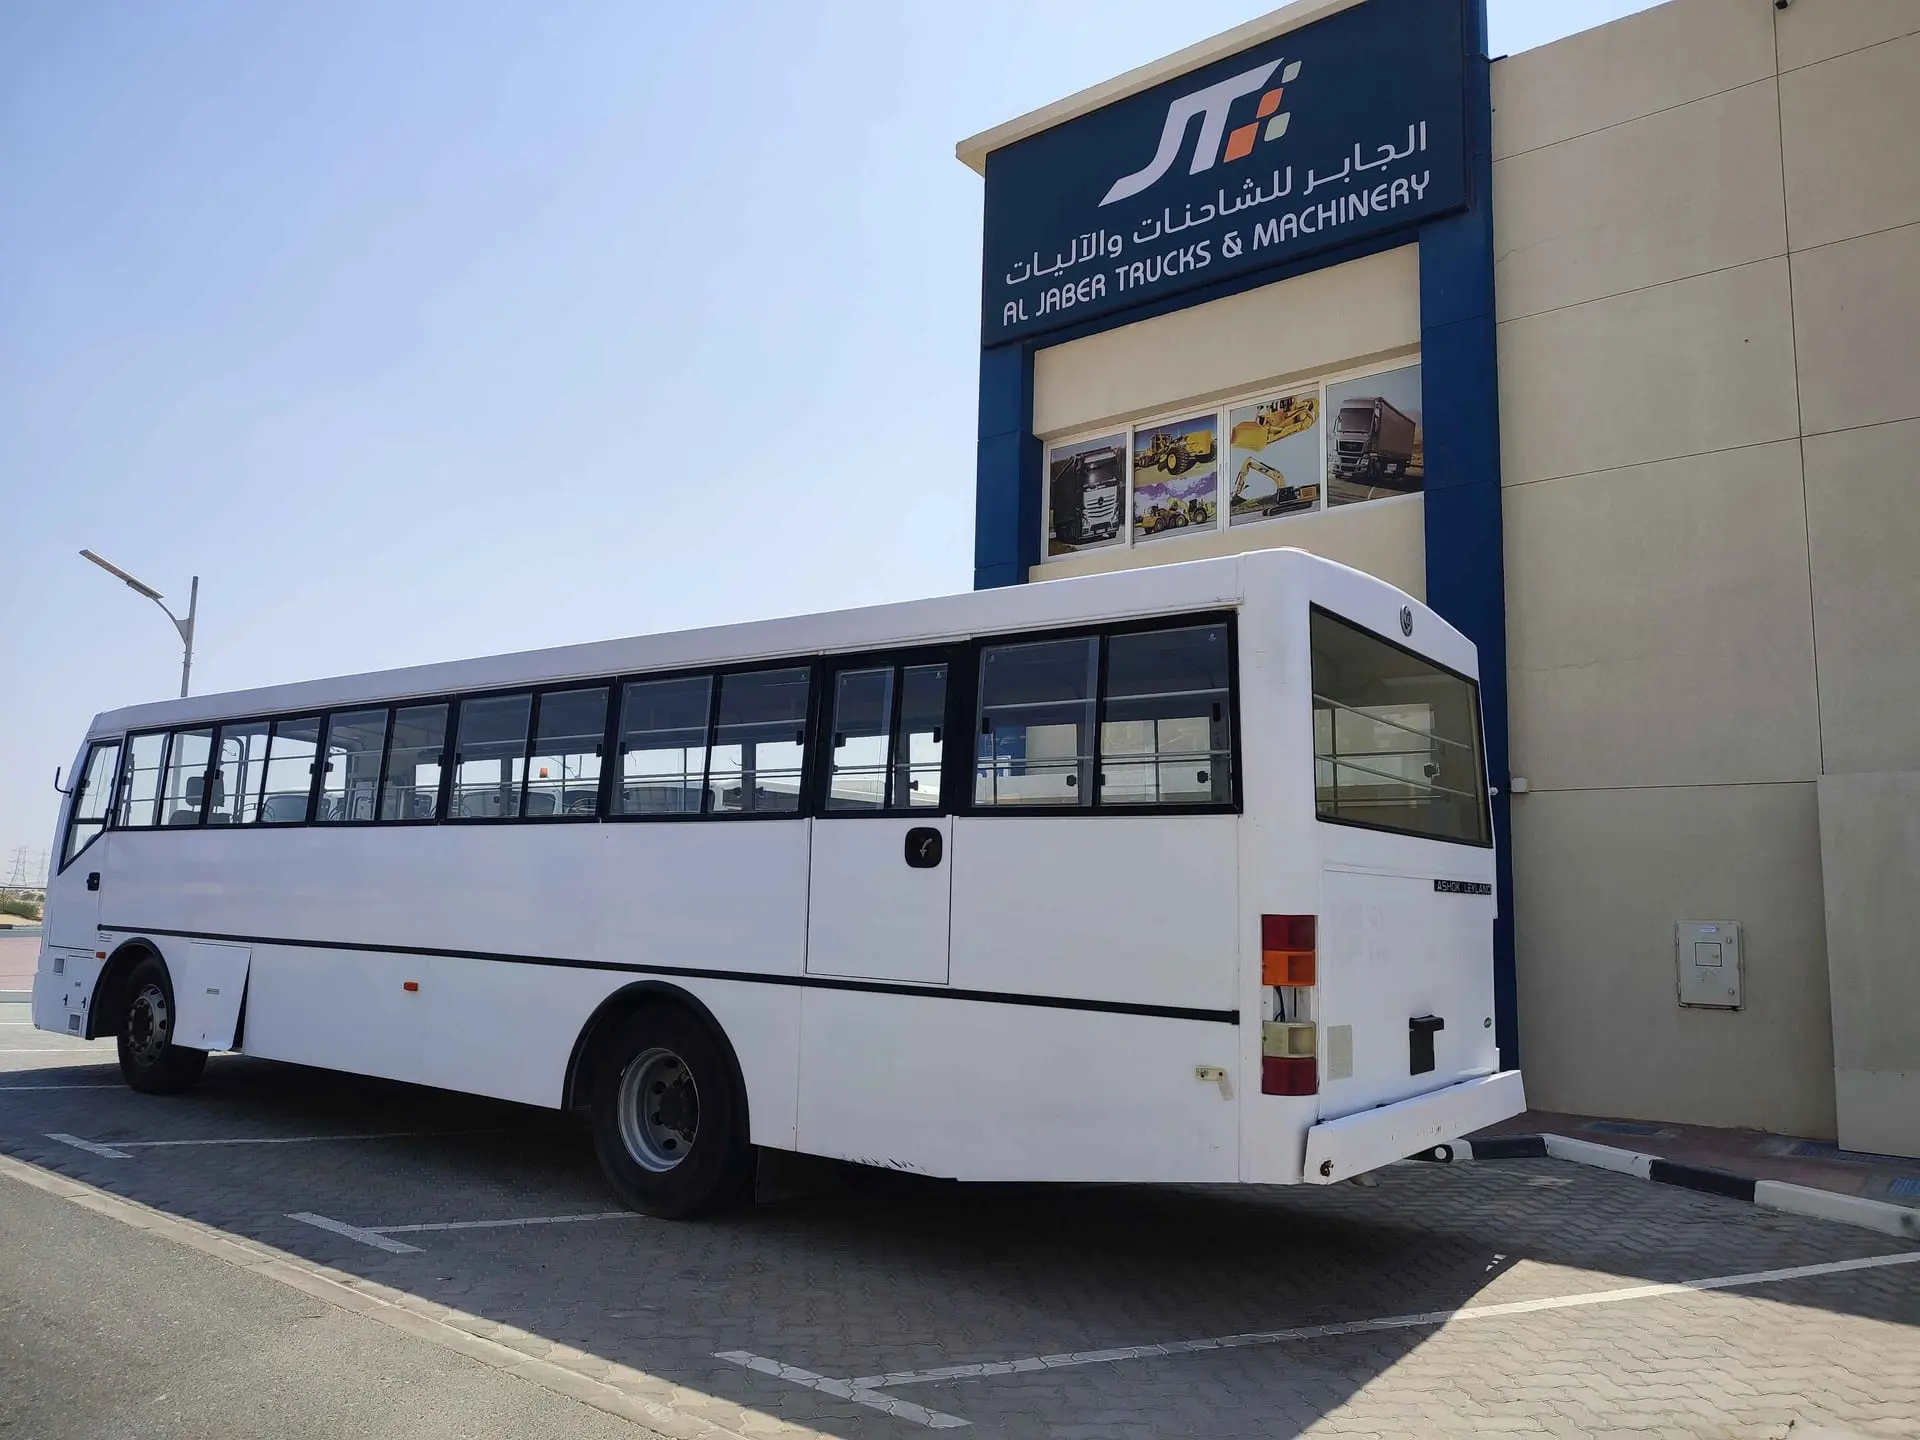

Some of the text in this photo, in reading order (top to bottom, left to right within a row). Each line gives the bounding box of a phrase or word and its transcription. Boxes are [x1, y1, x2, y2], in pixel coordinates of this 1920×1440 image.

[1304, 121, 1426, 196] الجابر
[1133, 166, 1292, 244] للشاحنات
[1003, 170, 1430, 326] AL JABER TRUCKS & MACHINERY
[1437, 880, 1491, 894] ASHOK LEYLAND
